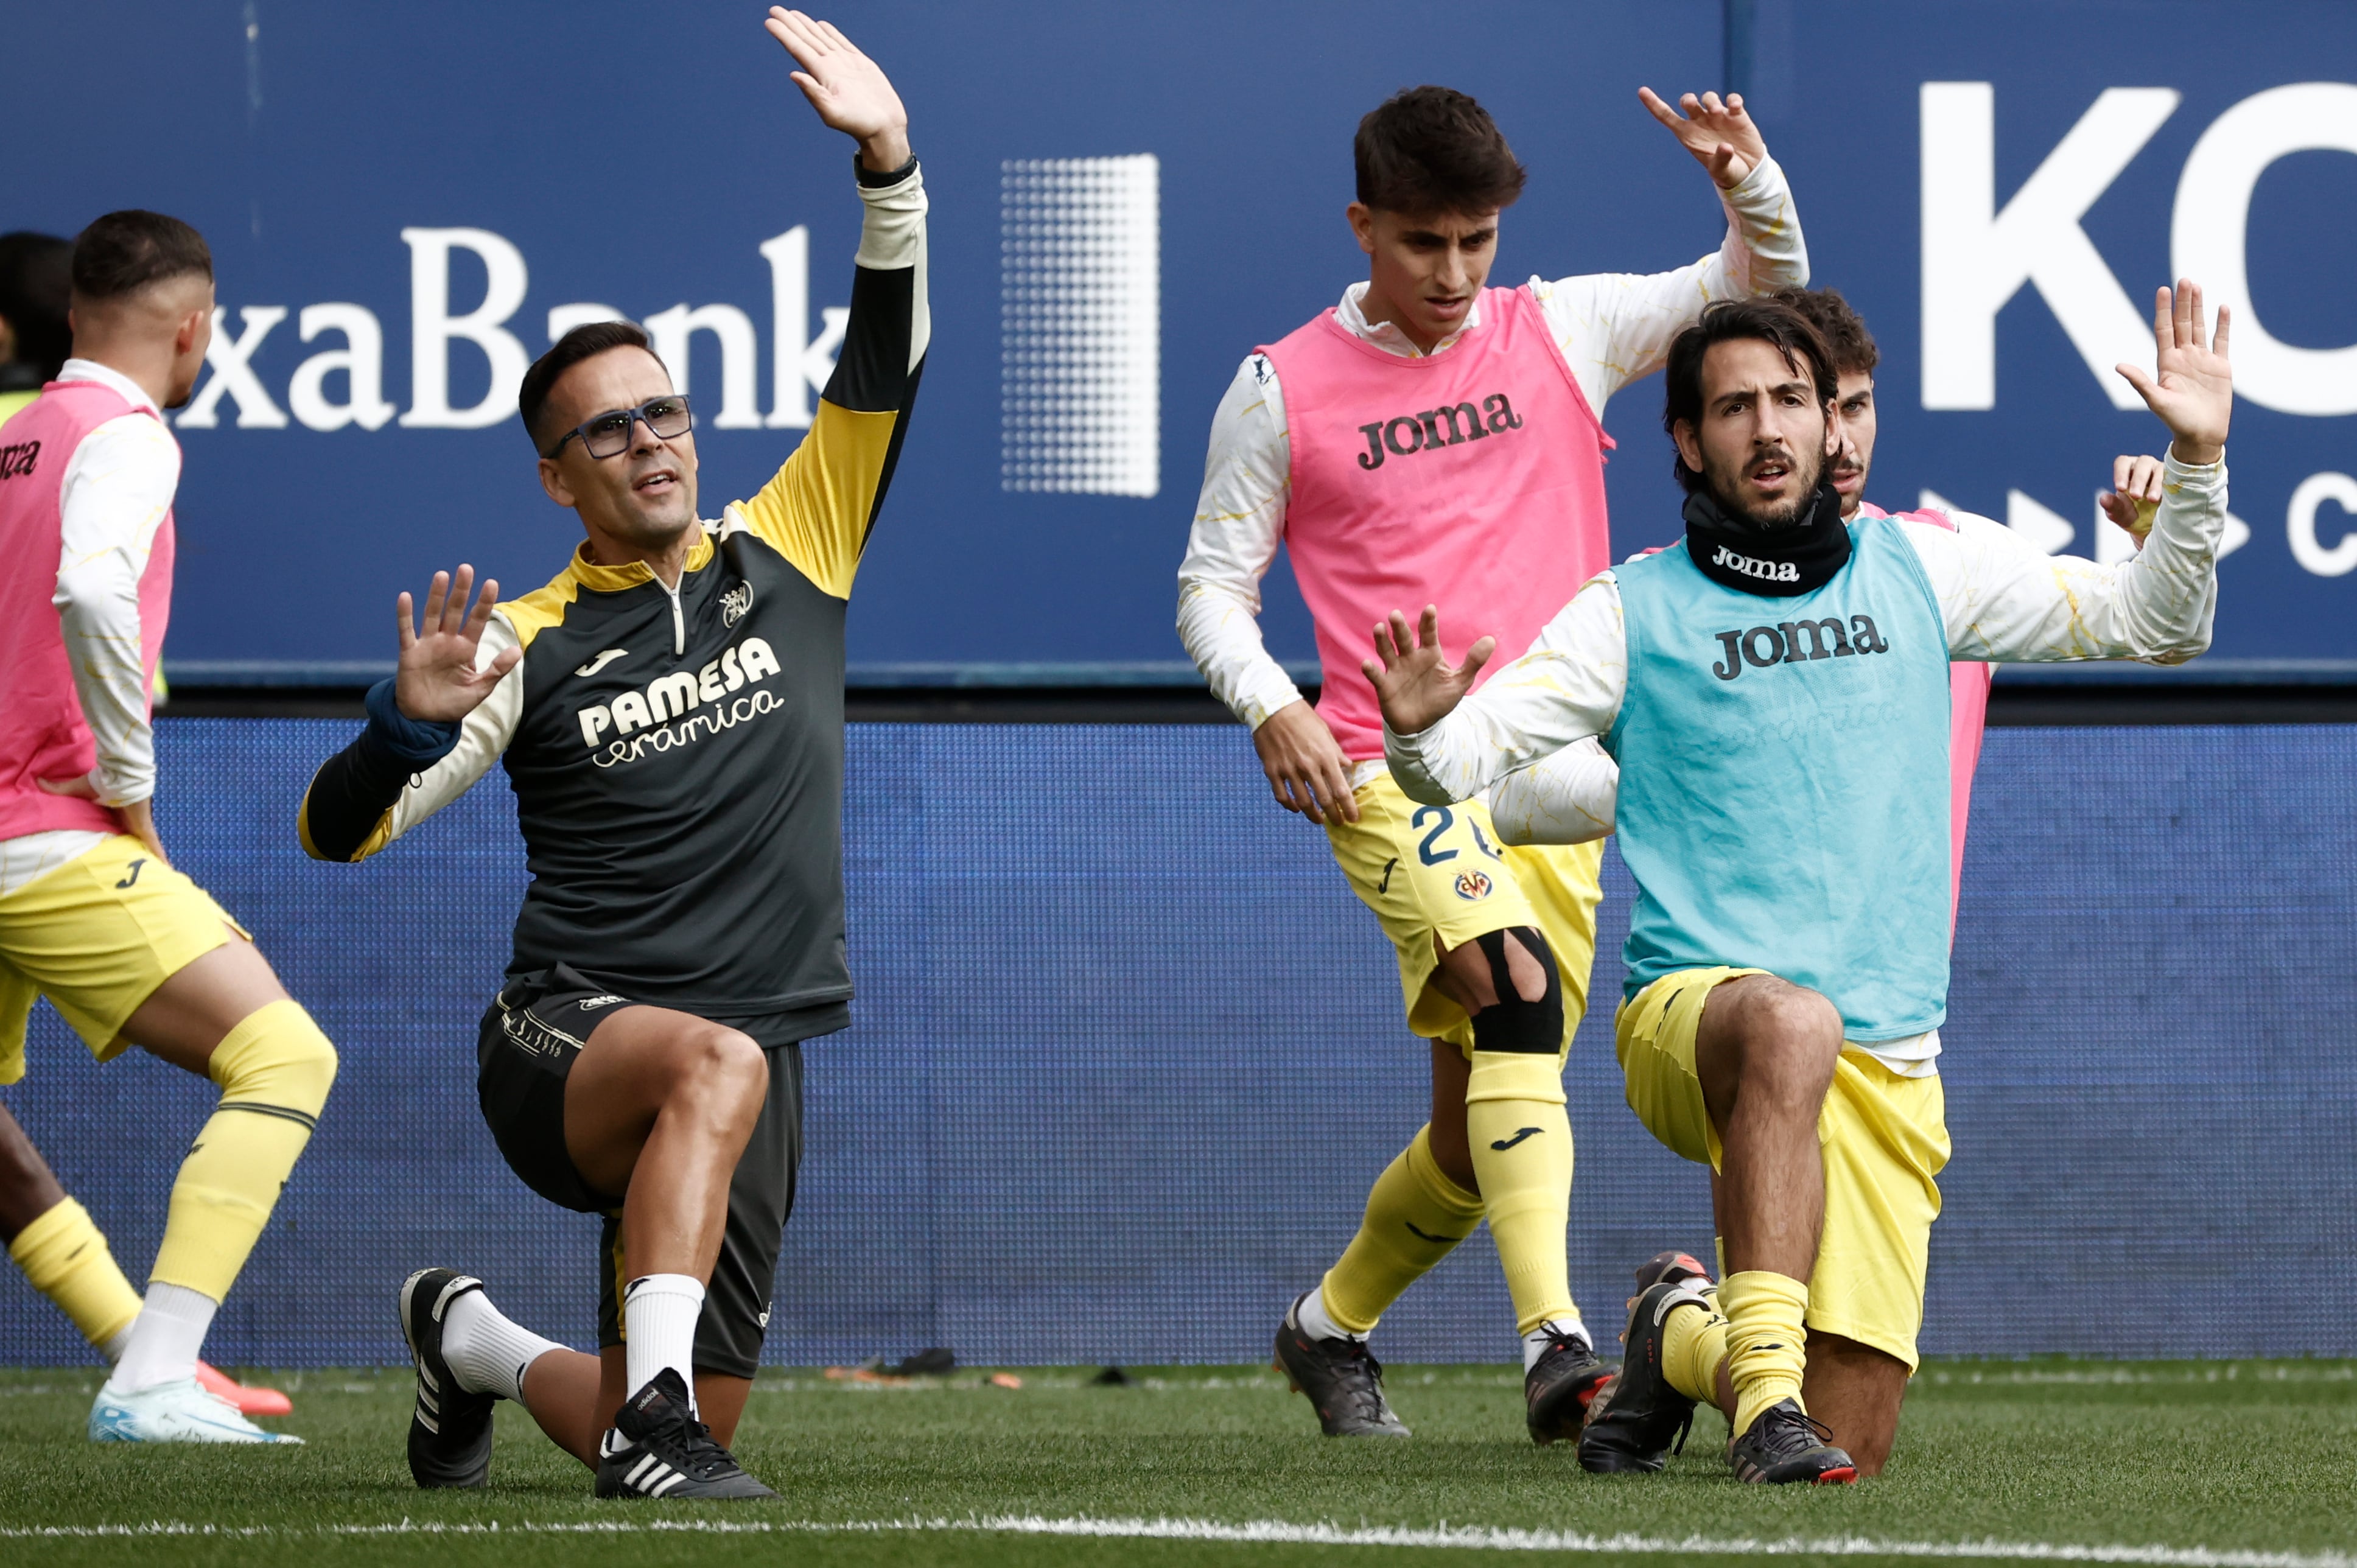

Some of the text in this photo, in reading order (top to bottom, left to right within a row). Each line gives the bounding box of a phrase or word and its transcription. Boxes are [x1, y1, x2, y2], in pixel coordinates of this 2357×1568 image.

[163, 225, 851, 432] xaBnk
[1357, 393, 1523, 471] Joma
[1712, 545, 1800, 583] Joma
[1712, 614, 1889, 681] Joma
[577, 637, 782, 748] PAMESA
